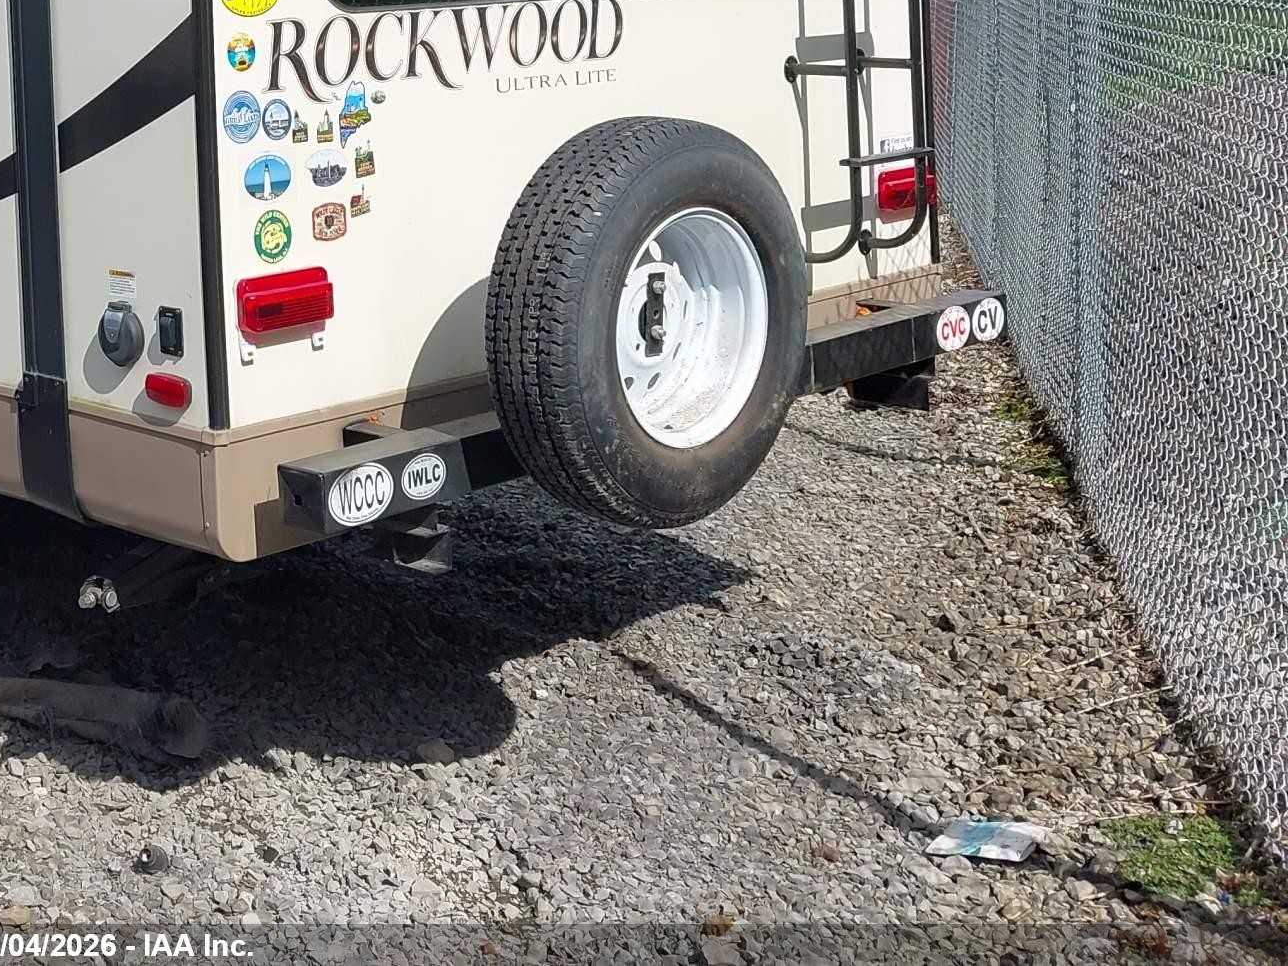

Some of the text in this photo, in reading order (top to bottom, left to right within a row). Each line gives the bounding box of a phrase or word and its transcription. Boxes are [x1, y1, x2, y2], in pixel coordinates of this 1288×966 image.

[495, 68, 617, 94] ULTRA LITE
[941, 316, 966, 341] CVC
[977, 305, 998, 334] CV
[407, 463, 441, 490] IWLC
[338, 470, 385, 516] WCCC
